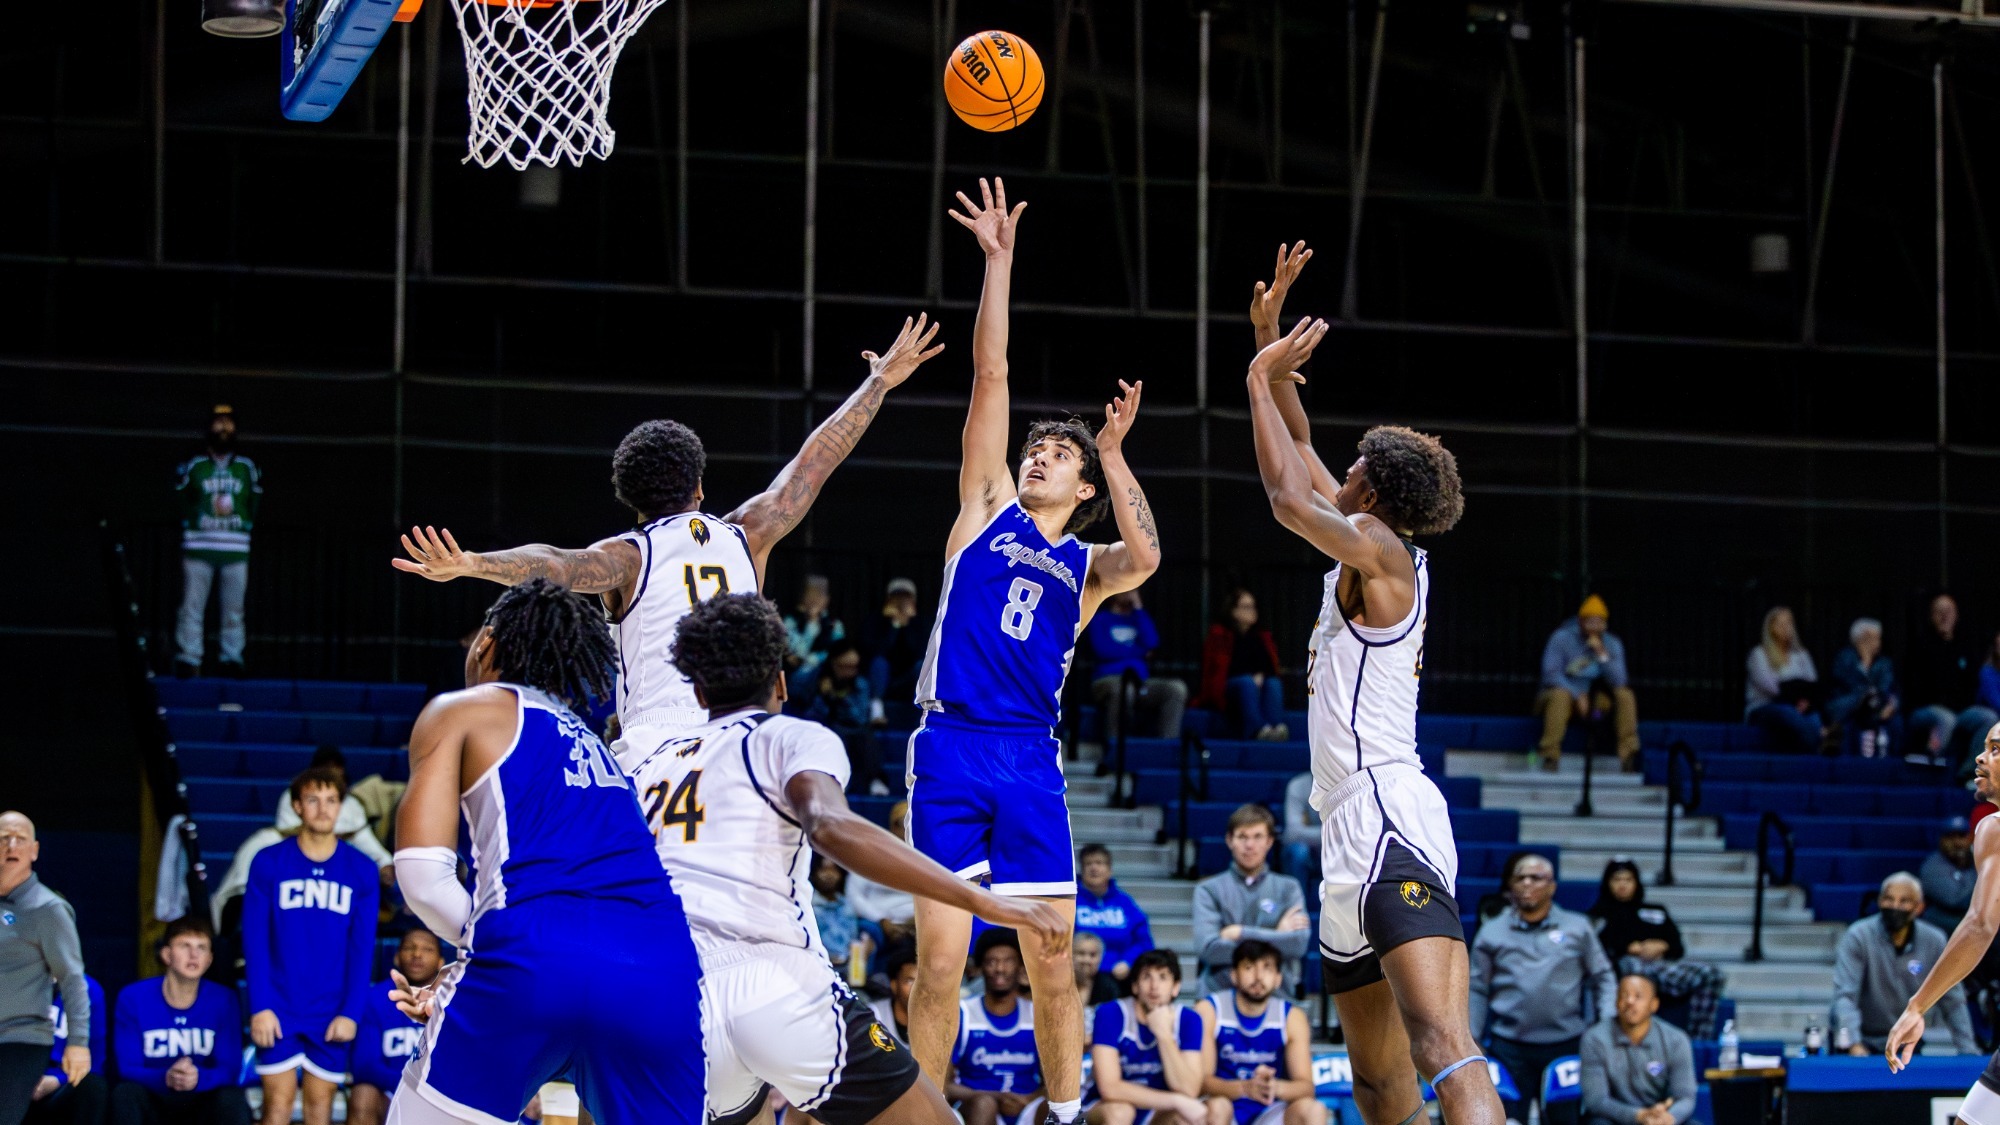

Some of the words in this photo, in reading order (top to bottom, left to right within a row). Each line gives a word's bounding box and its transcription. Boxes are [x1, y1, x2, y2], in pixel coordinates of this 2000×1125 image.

[988, 32, 1014, 58] NCA
[1000, 576, 1044, 641] 8
[557, 720, 630, 790] 30
[278, 878, 354, 916] CNU
[142, 1027, 217, 1058] CNU
[382, 1026, 425, 1058] CN
[1311, 1057, 1353, 1087] CN
